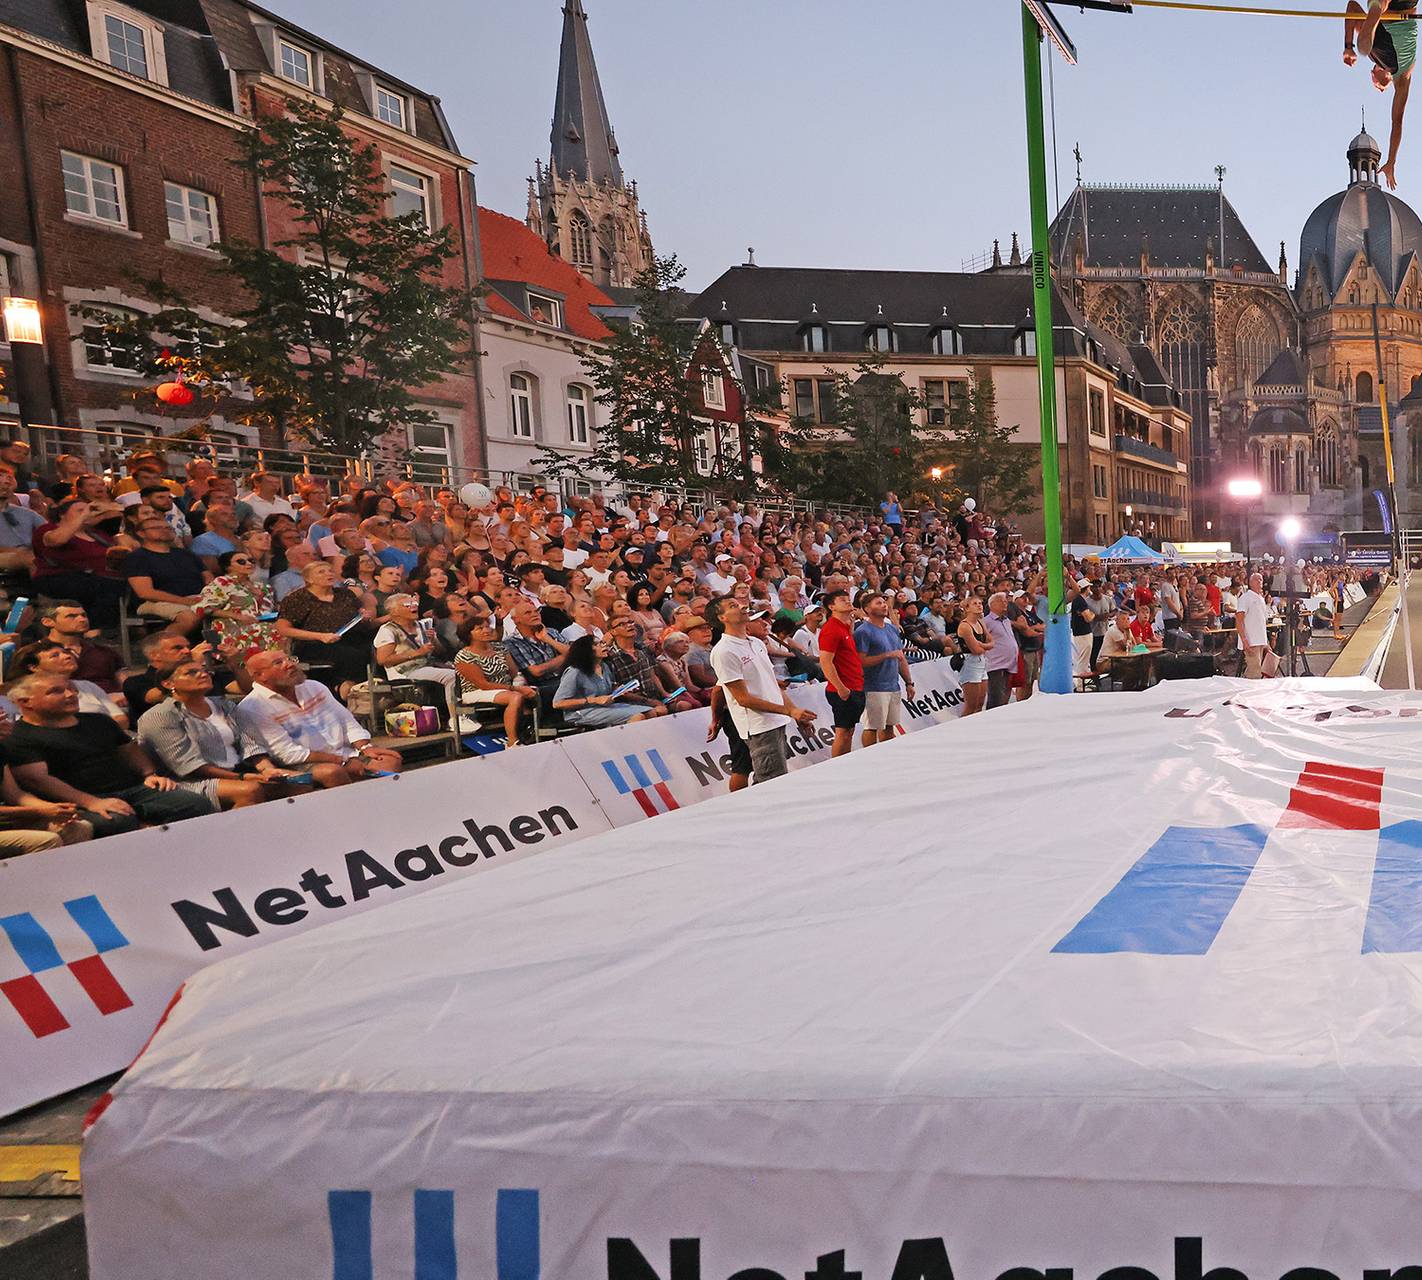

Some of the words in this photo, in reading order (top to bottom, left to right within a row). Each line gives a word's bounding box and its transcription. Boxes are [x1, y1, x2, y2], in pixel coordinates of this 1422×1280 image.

[1034, 250, 1045, 289] VINDICO
[901, 684, 965, 719] NetAac
[171, 803, 579, 952] NetAachen
